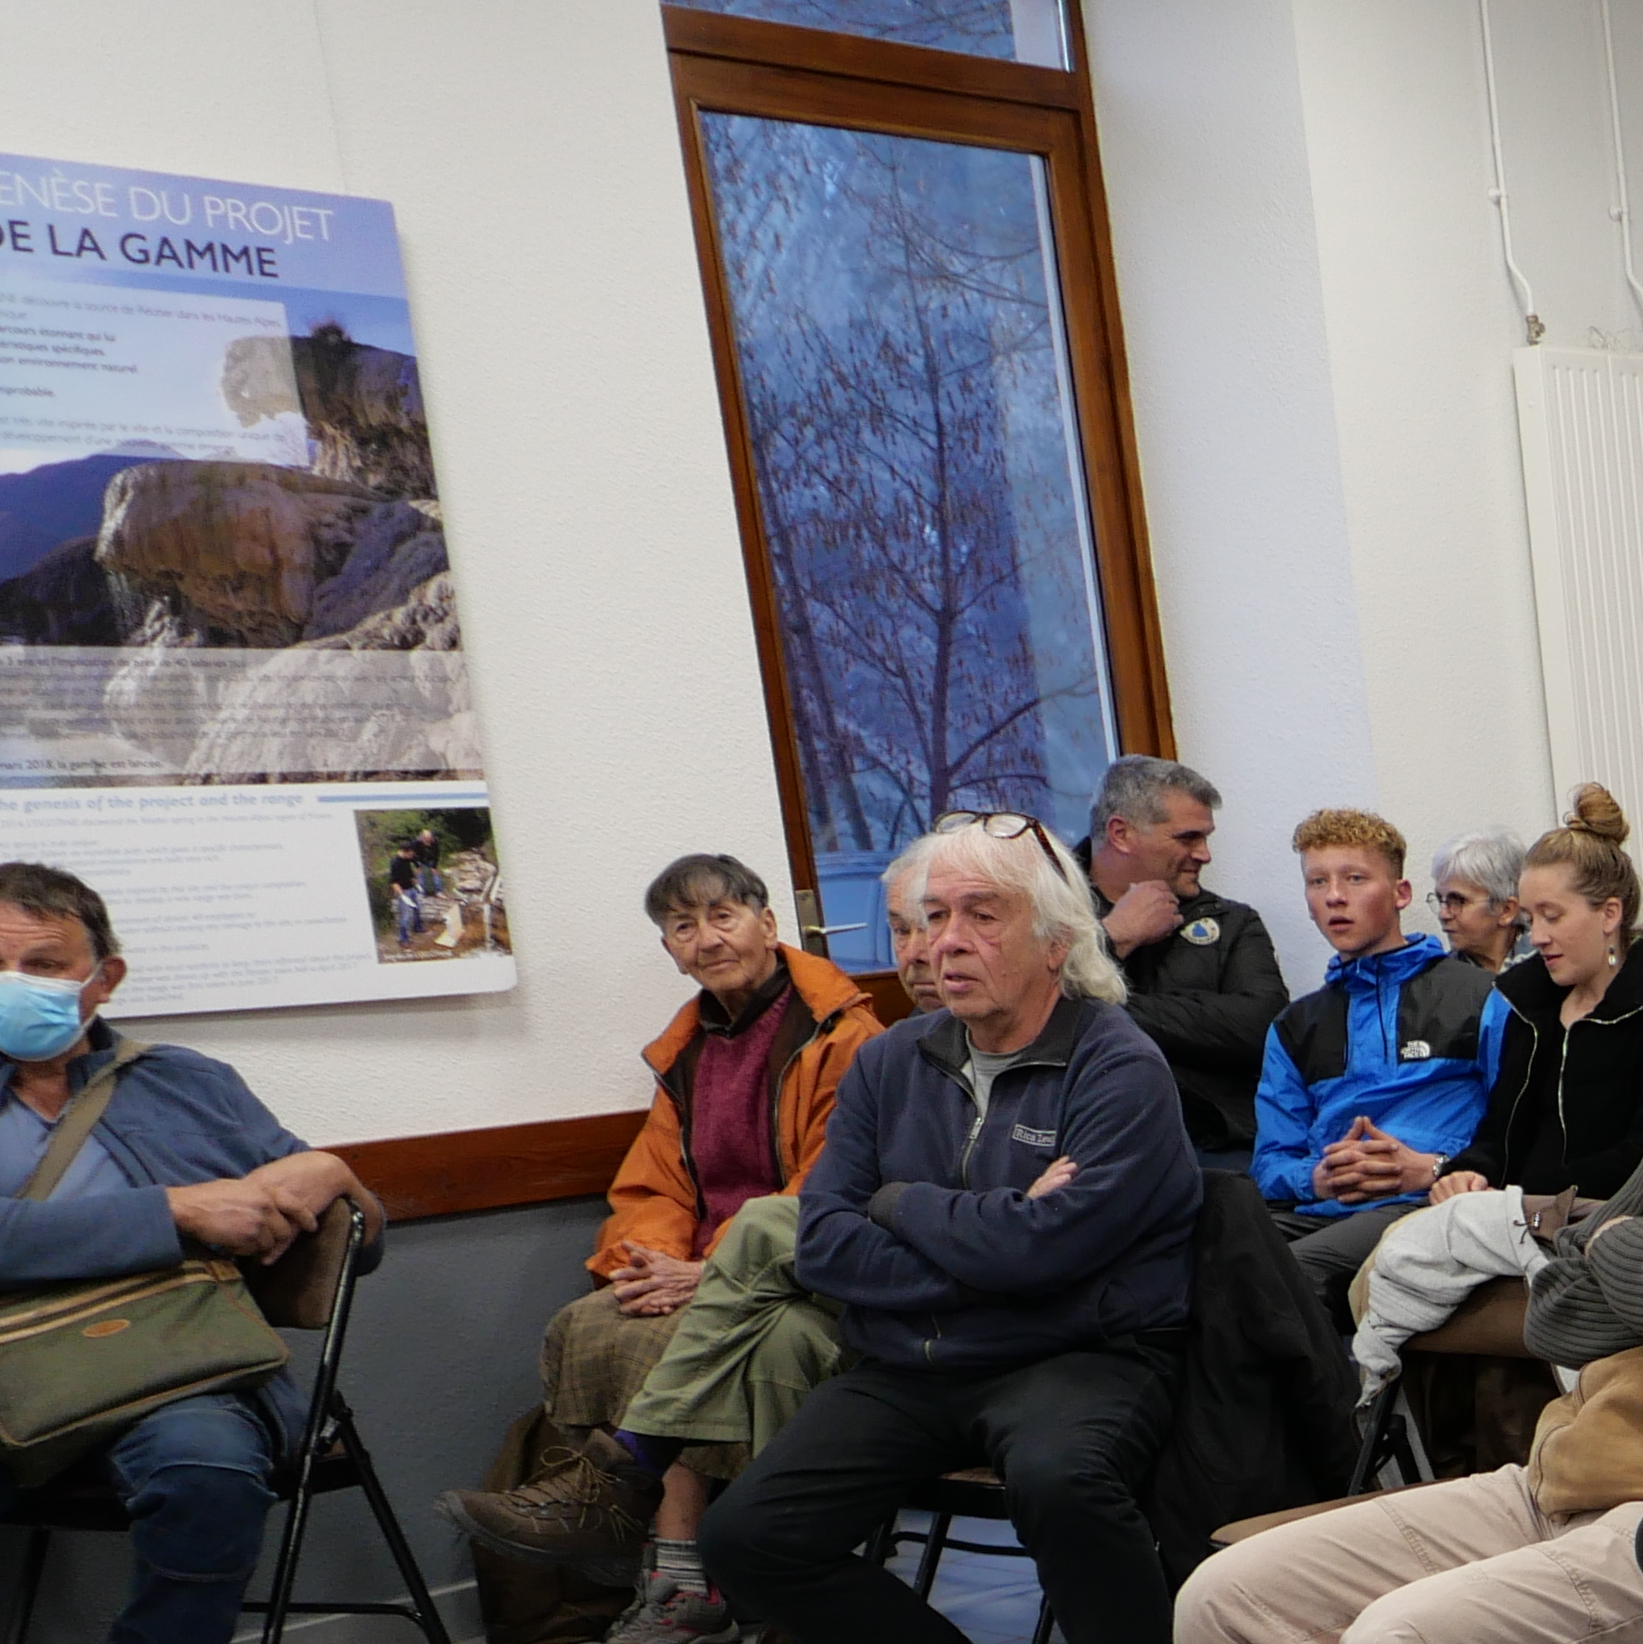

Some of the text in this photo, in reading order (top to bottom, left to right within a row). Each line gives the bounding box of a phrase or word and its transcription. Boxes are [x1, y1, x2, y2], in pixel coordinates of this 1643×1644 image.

[128, 185, 192, 226] DU
[203, 194, 334, 246] PROJET
[0, 219, 280, 279] E LA GAMME
